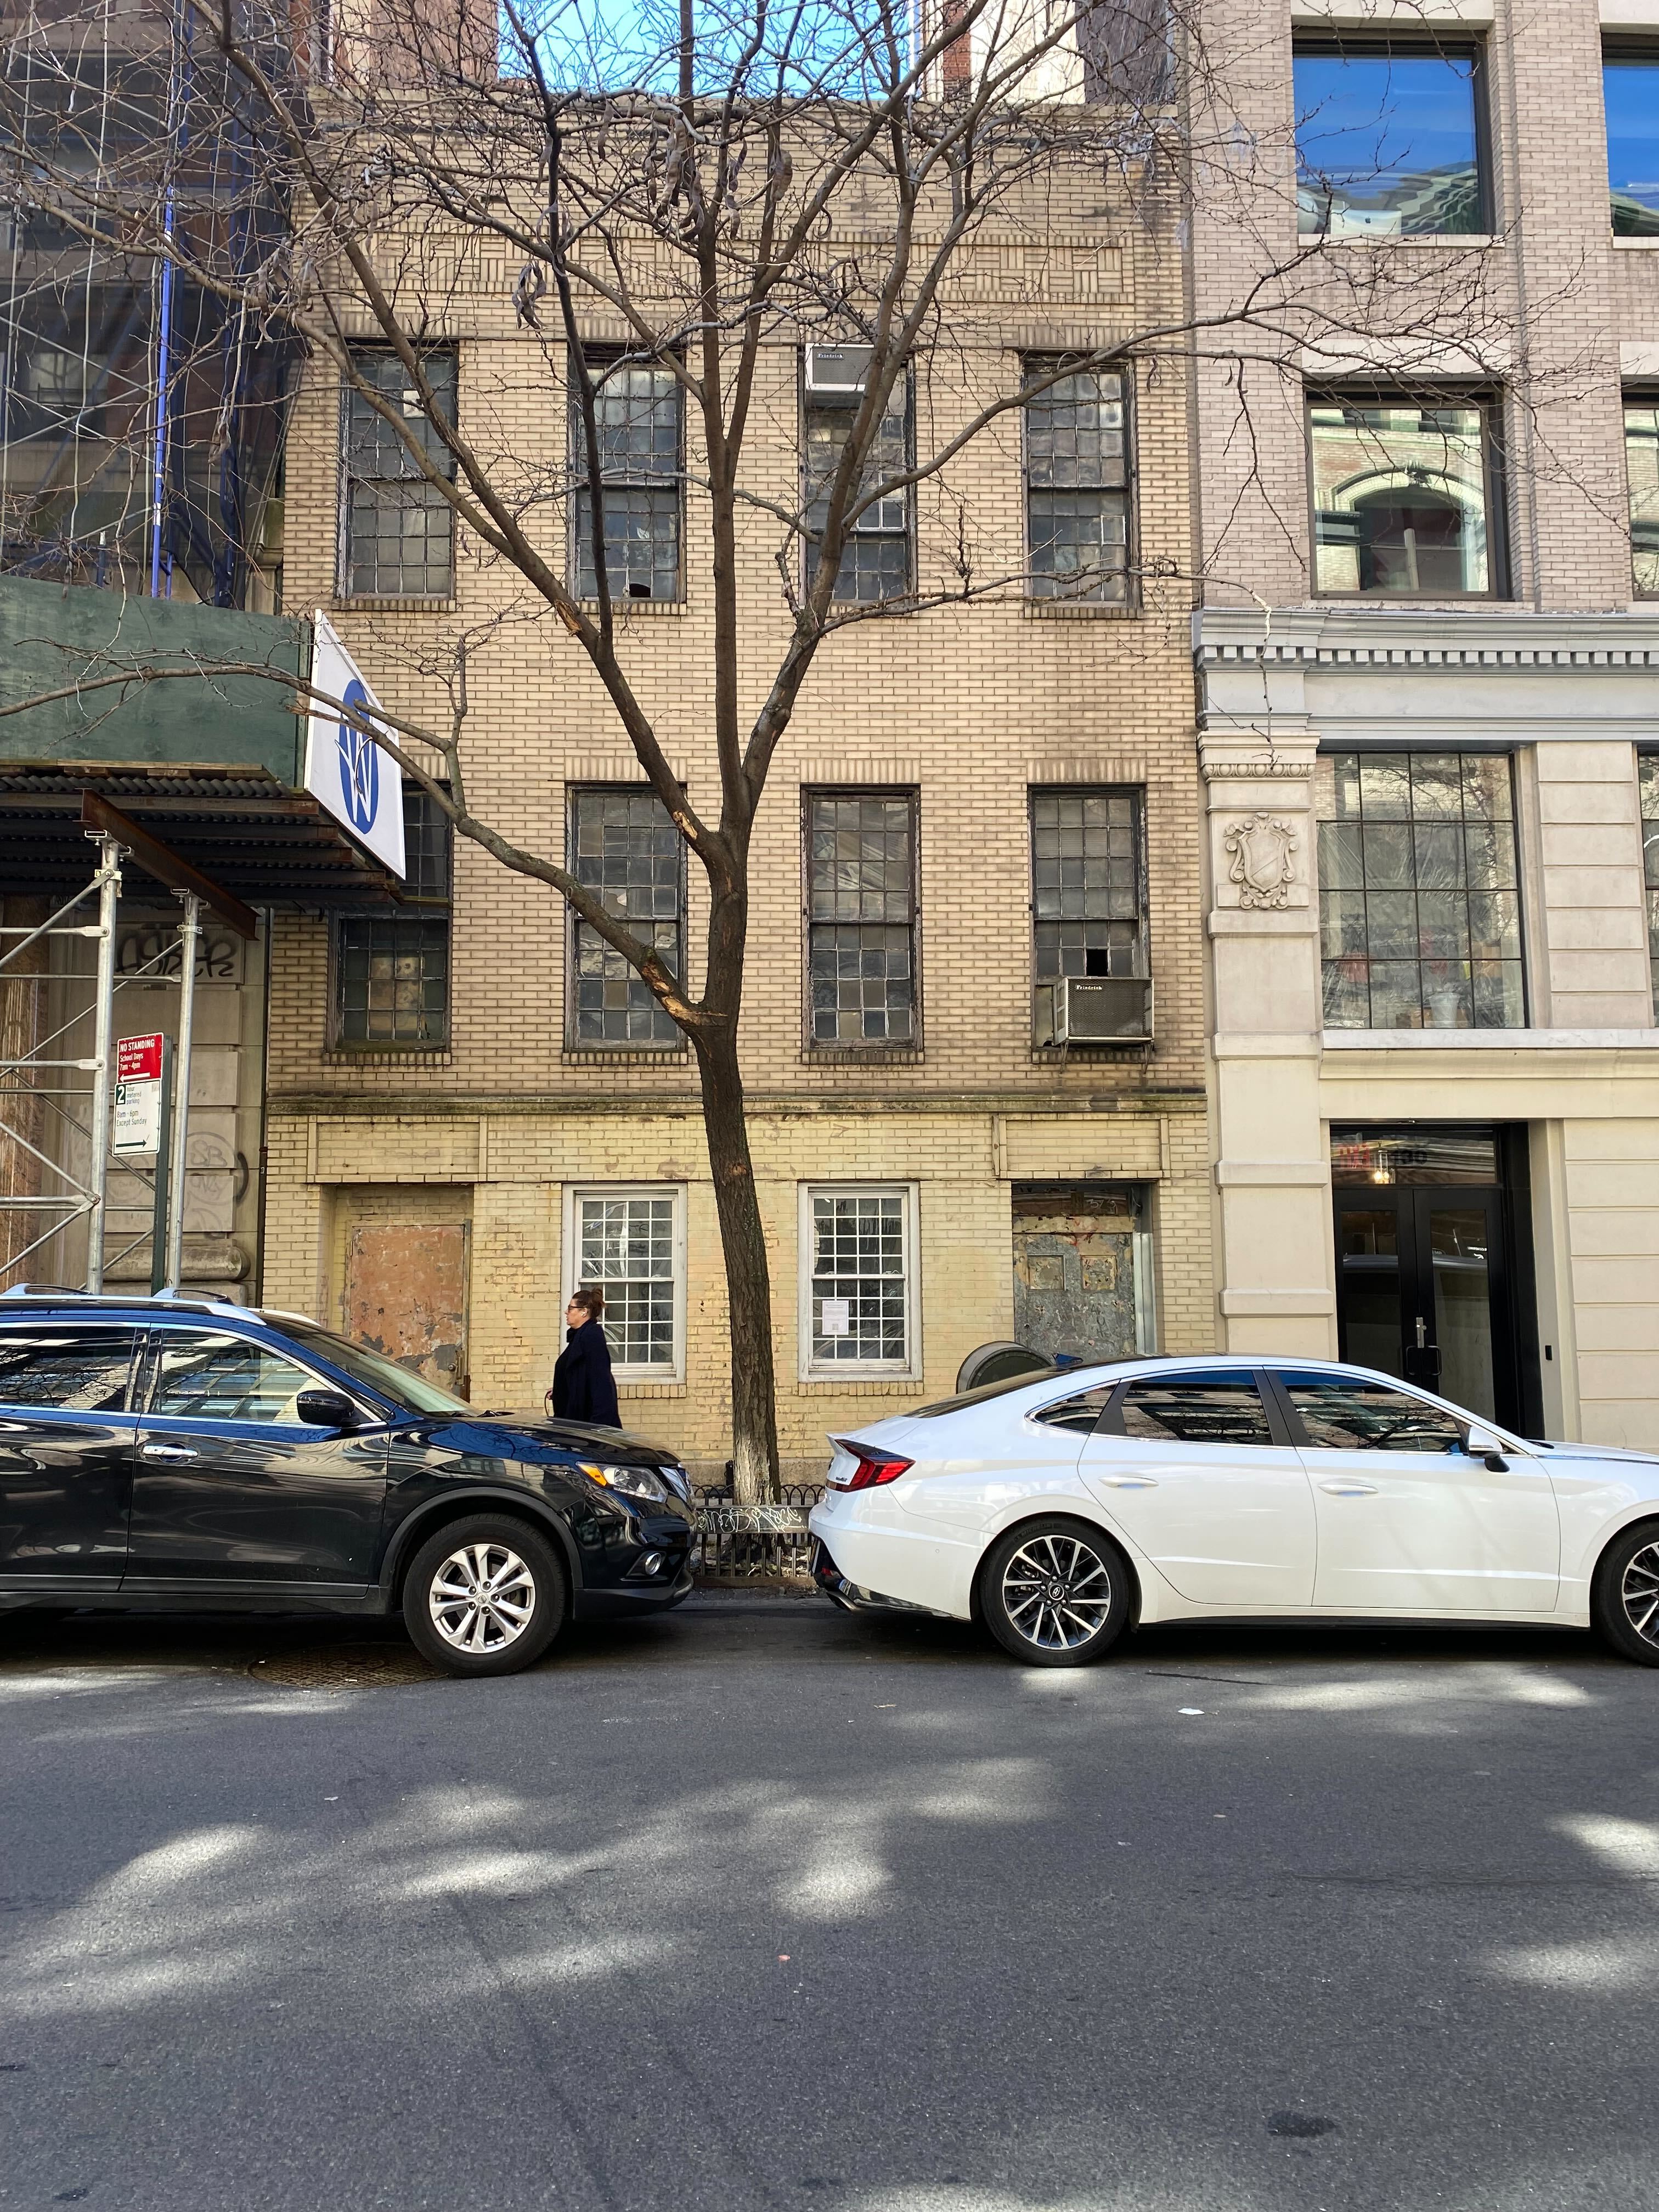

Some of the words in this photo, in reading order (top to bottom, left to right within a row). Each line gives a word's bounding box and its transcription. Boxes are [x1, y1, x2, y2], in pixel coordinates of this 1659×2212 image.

[120, 1043, 127, 1052] NO
[128, 1039, 155, 1051] STANDING
[120, 1053, 133, 1062] School
[133, 1052, 144, 1061] Days
[120, 1063, 128, 1071] 7am
[131, 1062, 141, 1071] 4pm
[117, 1085, 126, 1104] 2
[129, 1109, 139, 1118] 6pm
[116, 1119, 131, 1127] Except
[131, 1117, 147, 1125] Sunday
